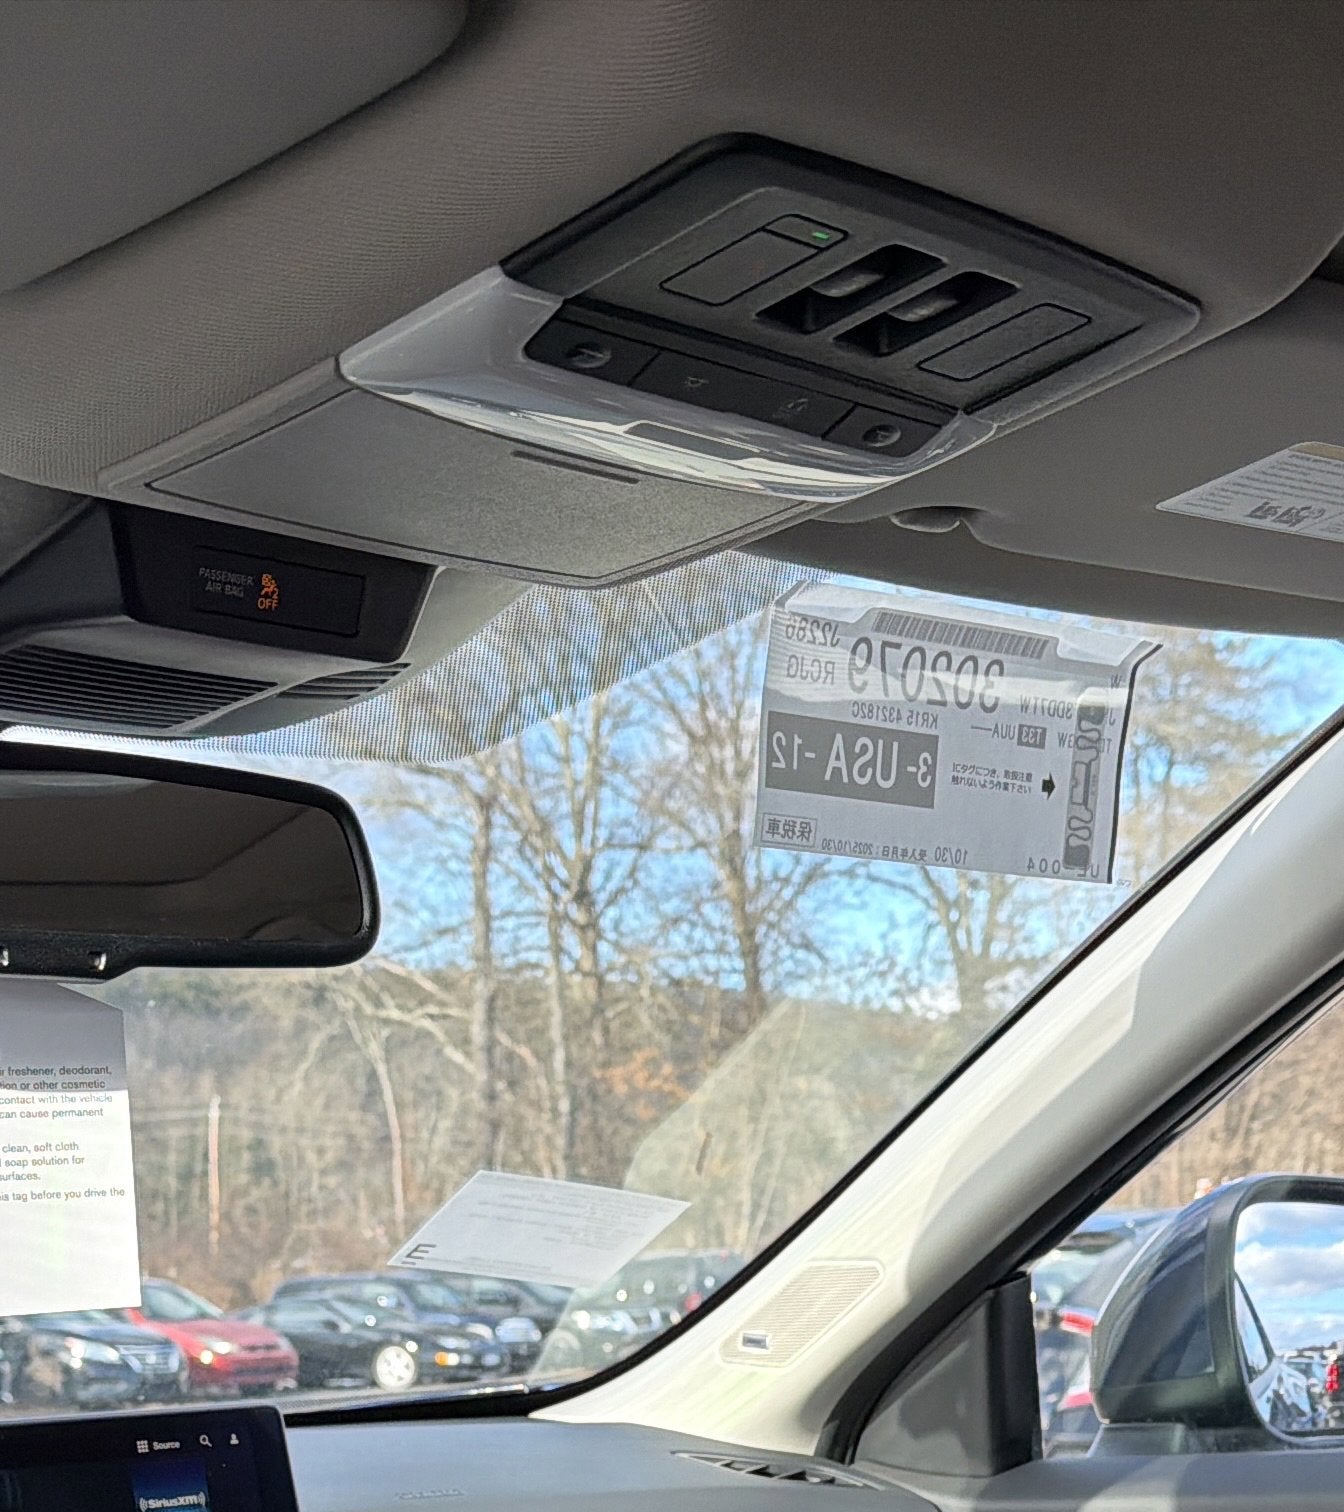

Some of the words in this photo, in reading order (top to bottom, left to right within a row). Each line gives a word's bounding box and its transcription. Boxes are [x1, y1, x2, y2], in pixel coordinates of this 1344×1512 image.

[198, 568, 254, 586] PASSENGER
[206, 581, 223, 592] AIR
[225, 584, 244, 597] BAG
[258, 598, 278, 610] OFF
[8, 1066, 56, 1077] freshener,
[59, 1065, 112, 1076] deodorant,
[33, 1080, 58, 1089] other
[62, 1079, 106, 1089] cosmetic
[38, 1095, 58, 1104] with
[61, 1094, 76, 1103] the
[80, 1093, 113, 1103] vehicle
[0, 1111, 17, 1119] can
[20, 1110, 49, 1118] cause
[52, 1108, 103, 1120] permanent
[2, 1143, 31, 1154] clean,
[34, 1142, 52, 1152] soft
[55, 1141, 79, 1151] cloth
[5, 1159, 28, 1169] soap
[32, 1156, 69, 1166] solution
[72, 1155, 85, 1164] for
[12, 1192, 28, 1202] tag
[31, 1189, 61, 1200] before
[64, 1190, 81, 1201] you
[84, 1188, 107, 1198] drive
[110, 1187, 125, 1196] the
[152, 1439, 181, 1450] Source
